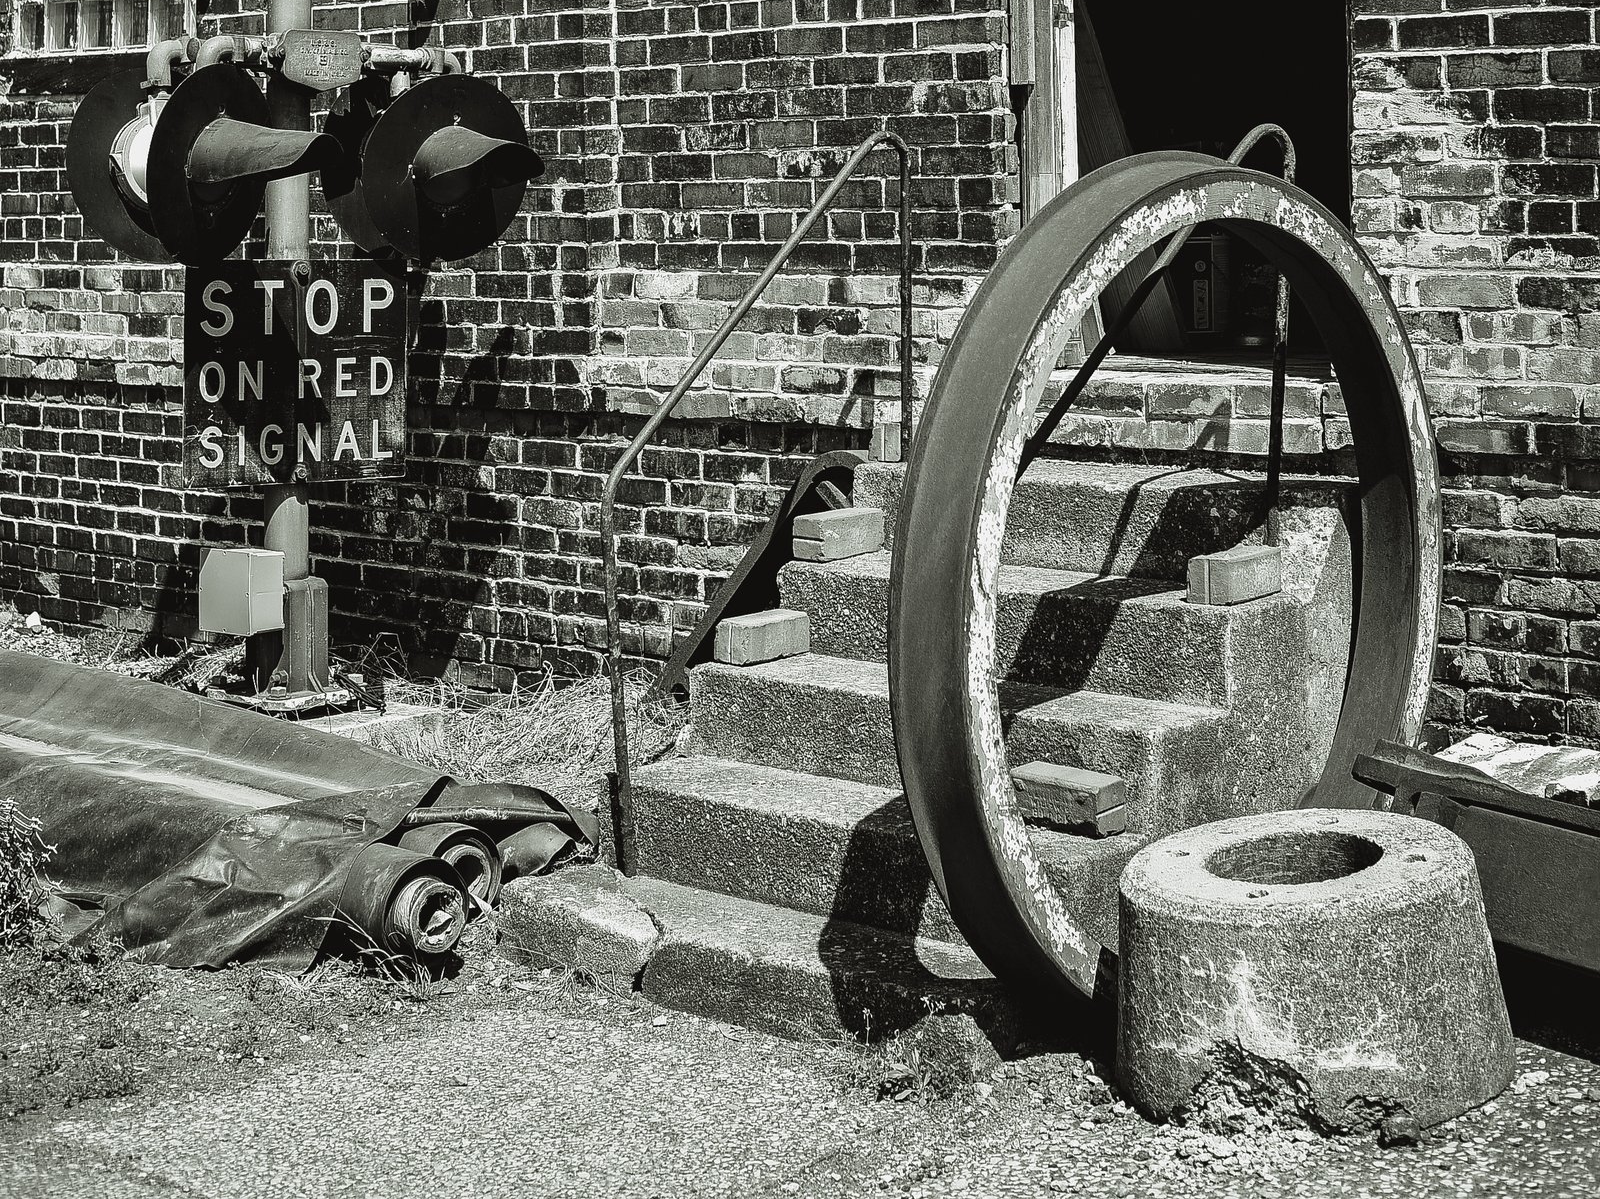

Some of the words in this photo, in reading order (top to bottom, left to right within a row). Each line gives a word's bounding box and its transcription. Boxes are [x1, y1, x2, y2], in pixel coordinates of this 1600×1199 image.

[199, 278, 395, 337] STOP
[199, 360, 264, 403] ON
[298, 356, 394, 399] RED
[199, 418, 393, 469] SIGNAL
